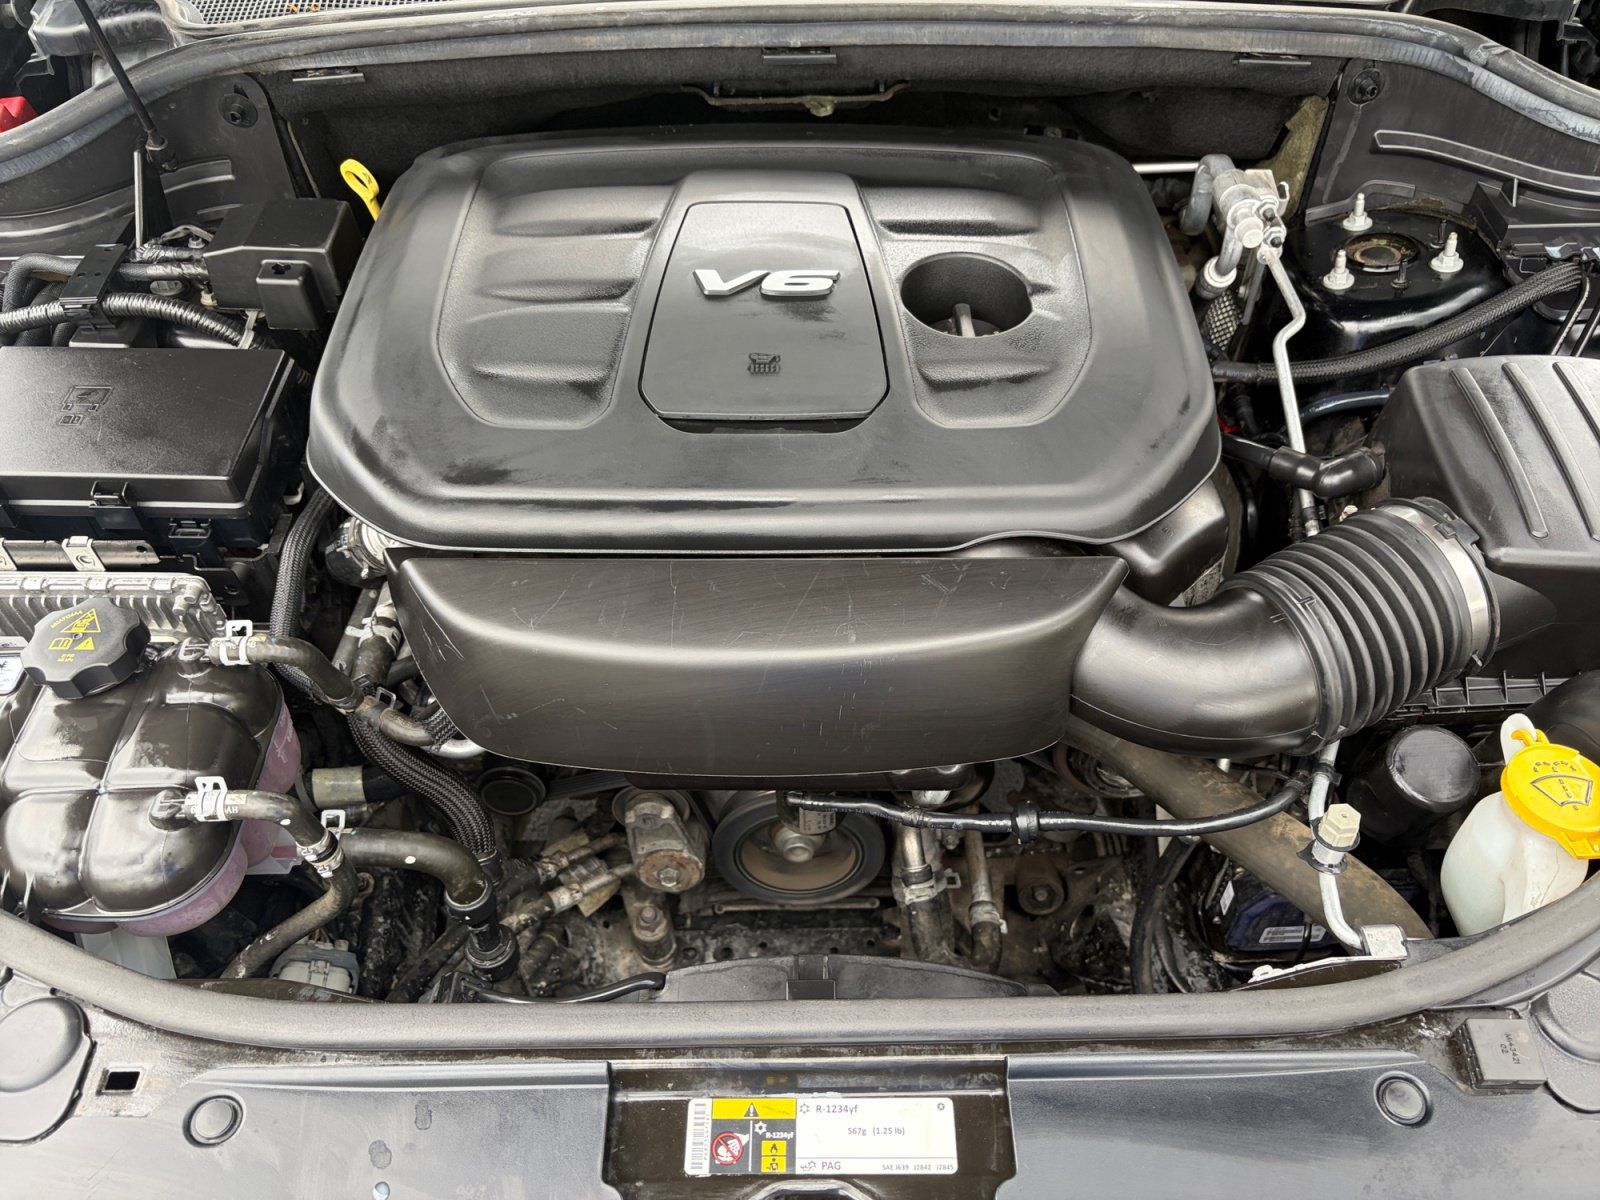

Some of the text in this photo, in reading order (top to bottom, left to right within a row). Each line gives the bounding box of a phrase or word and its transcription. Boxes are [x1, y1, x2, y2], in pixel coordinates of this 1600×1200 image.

[692, 269, 841, 297] V6
[815, 1104, 859, 1116] R-1234yf
[766, 1131, 794, 1139] R-1234yf
[848, 1127, 868, 1137] 567g
[872, 1126, 893, 1137] (1.25
[821, 1161, 842, 1171] PAG
[881, 1163, 894, 1171] SAE
